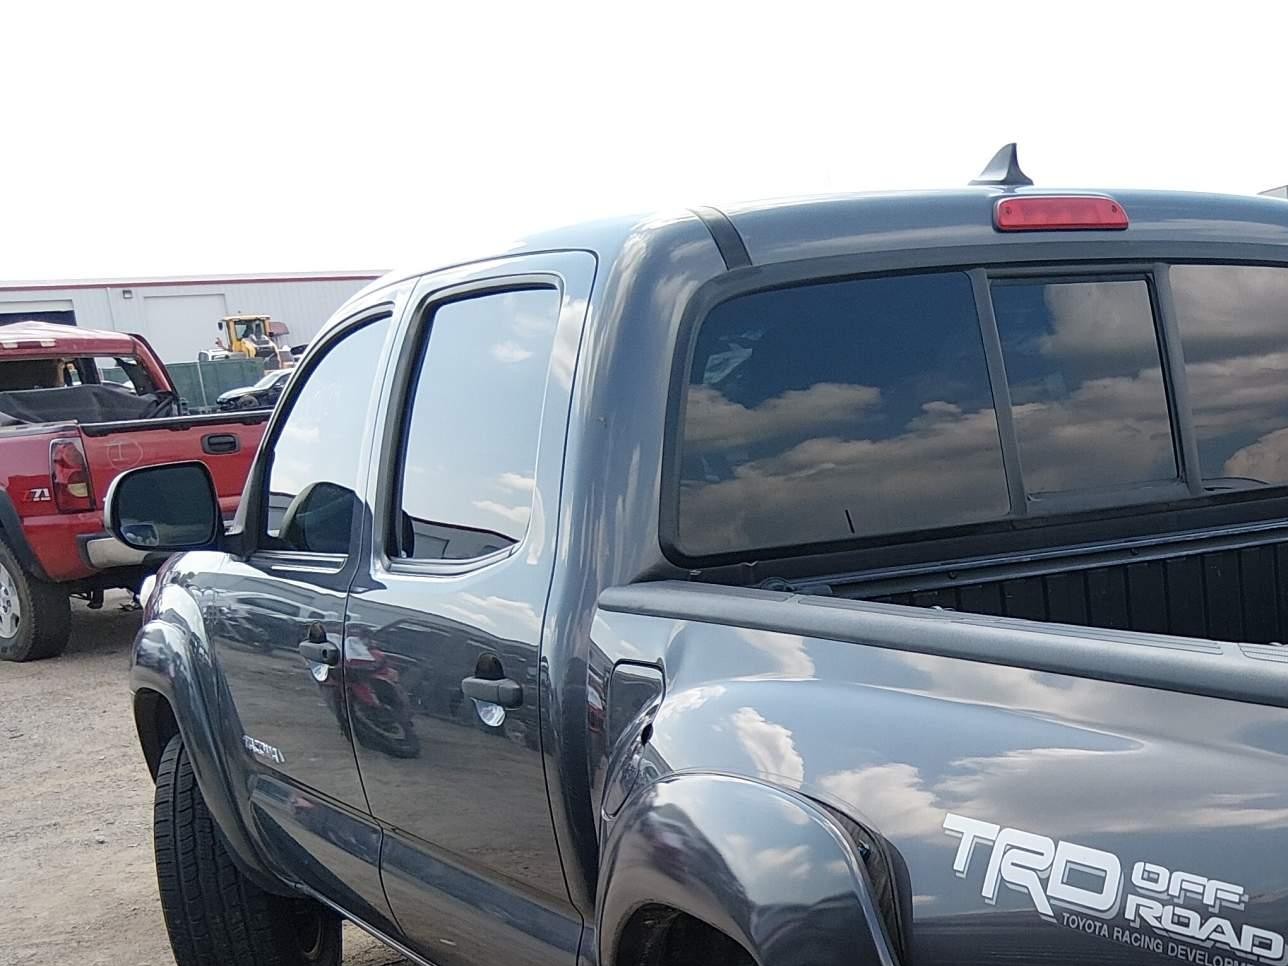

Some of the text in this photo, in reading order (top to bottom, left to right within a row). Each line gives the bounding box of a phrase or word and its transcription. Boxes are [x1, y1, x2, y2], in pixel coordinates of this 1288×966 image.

[942, 812, 1125, 923] TRD
[1131, 861, 1249, 912] OFF
[1061, 912, 1109, 938] TOYOTA
[1113, 926, 1164, 954] RACING
[1124, 894, 1288, 966] ROAD
